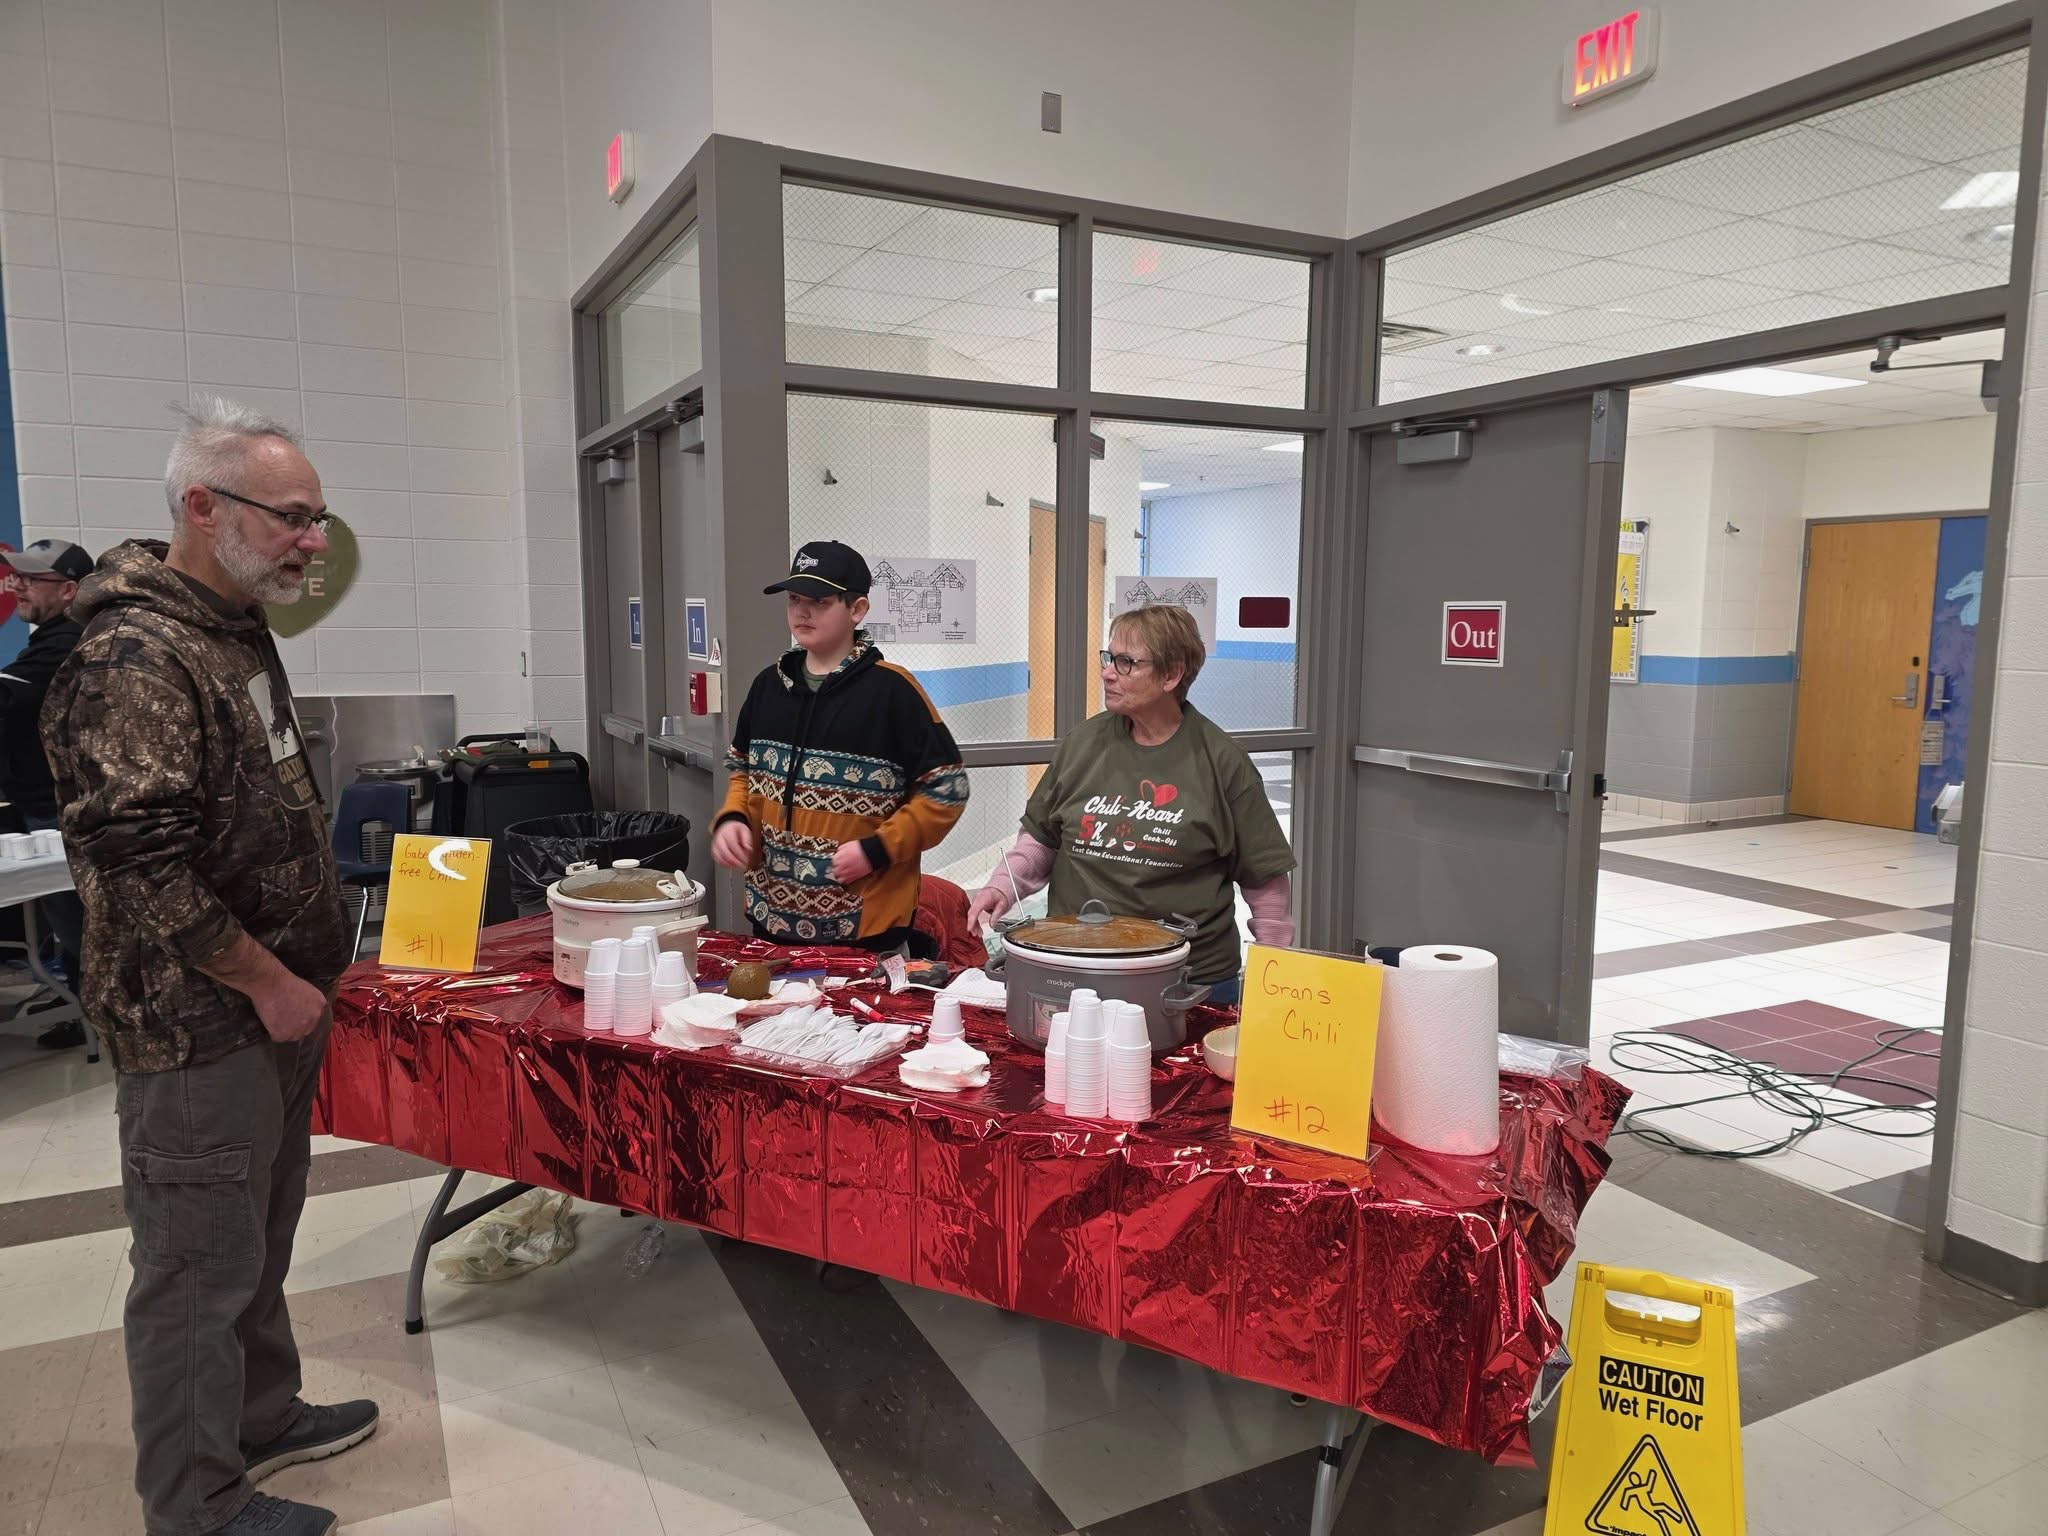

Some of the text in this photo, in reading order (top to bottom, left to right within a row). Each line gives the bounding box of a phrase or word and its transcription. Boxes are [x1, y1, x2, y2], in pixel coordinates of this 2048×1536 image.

[1574, 10, 1640, 97] EXIT
[691, 618, 702, 644] In
[1450, 620, 1497, 649] Out
[1084, 795, 1185, 824] Chili-Heart
[1078, 814, 1108, 841] 5K
[398, 862, 421, 878] free
[1101, 851, 1143, 864] Educational
[1144, 858, 1184, 869] Foundation
[405, 932, 443, 964] #11
[1262, 959, 1331, 1005] Grans
[1283, 1008, 1343, 1045] Chili
[1263, 1095, 1330, 1134] #12
[1602, 1360, 1702, 1403] CAUTION
[1599, 1387, 1704, 1432] Wet Floor
